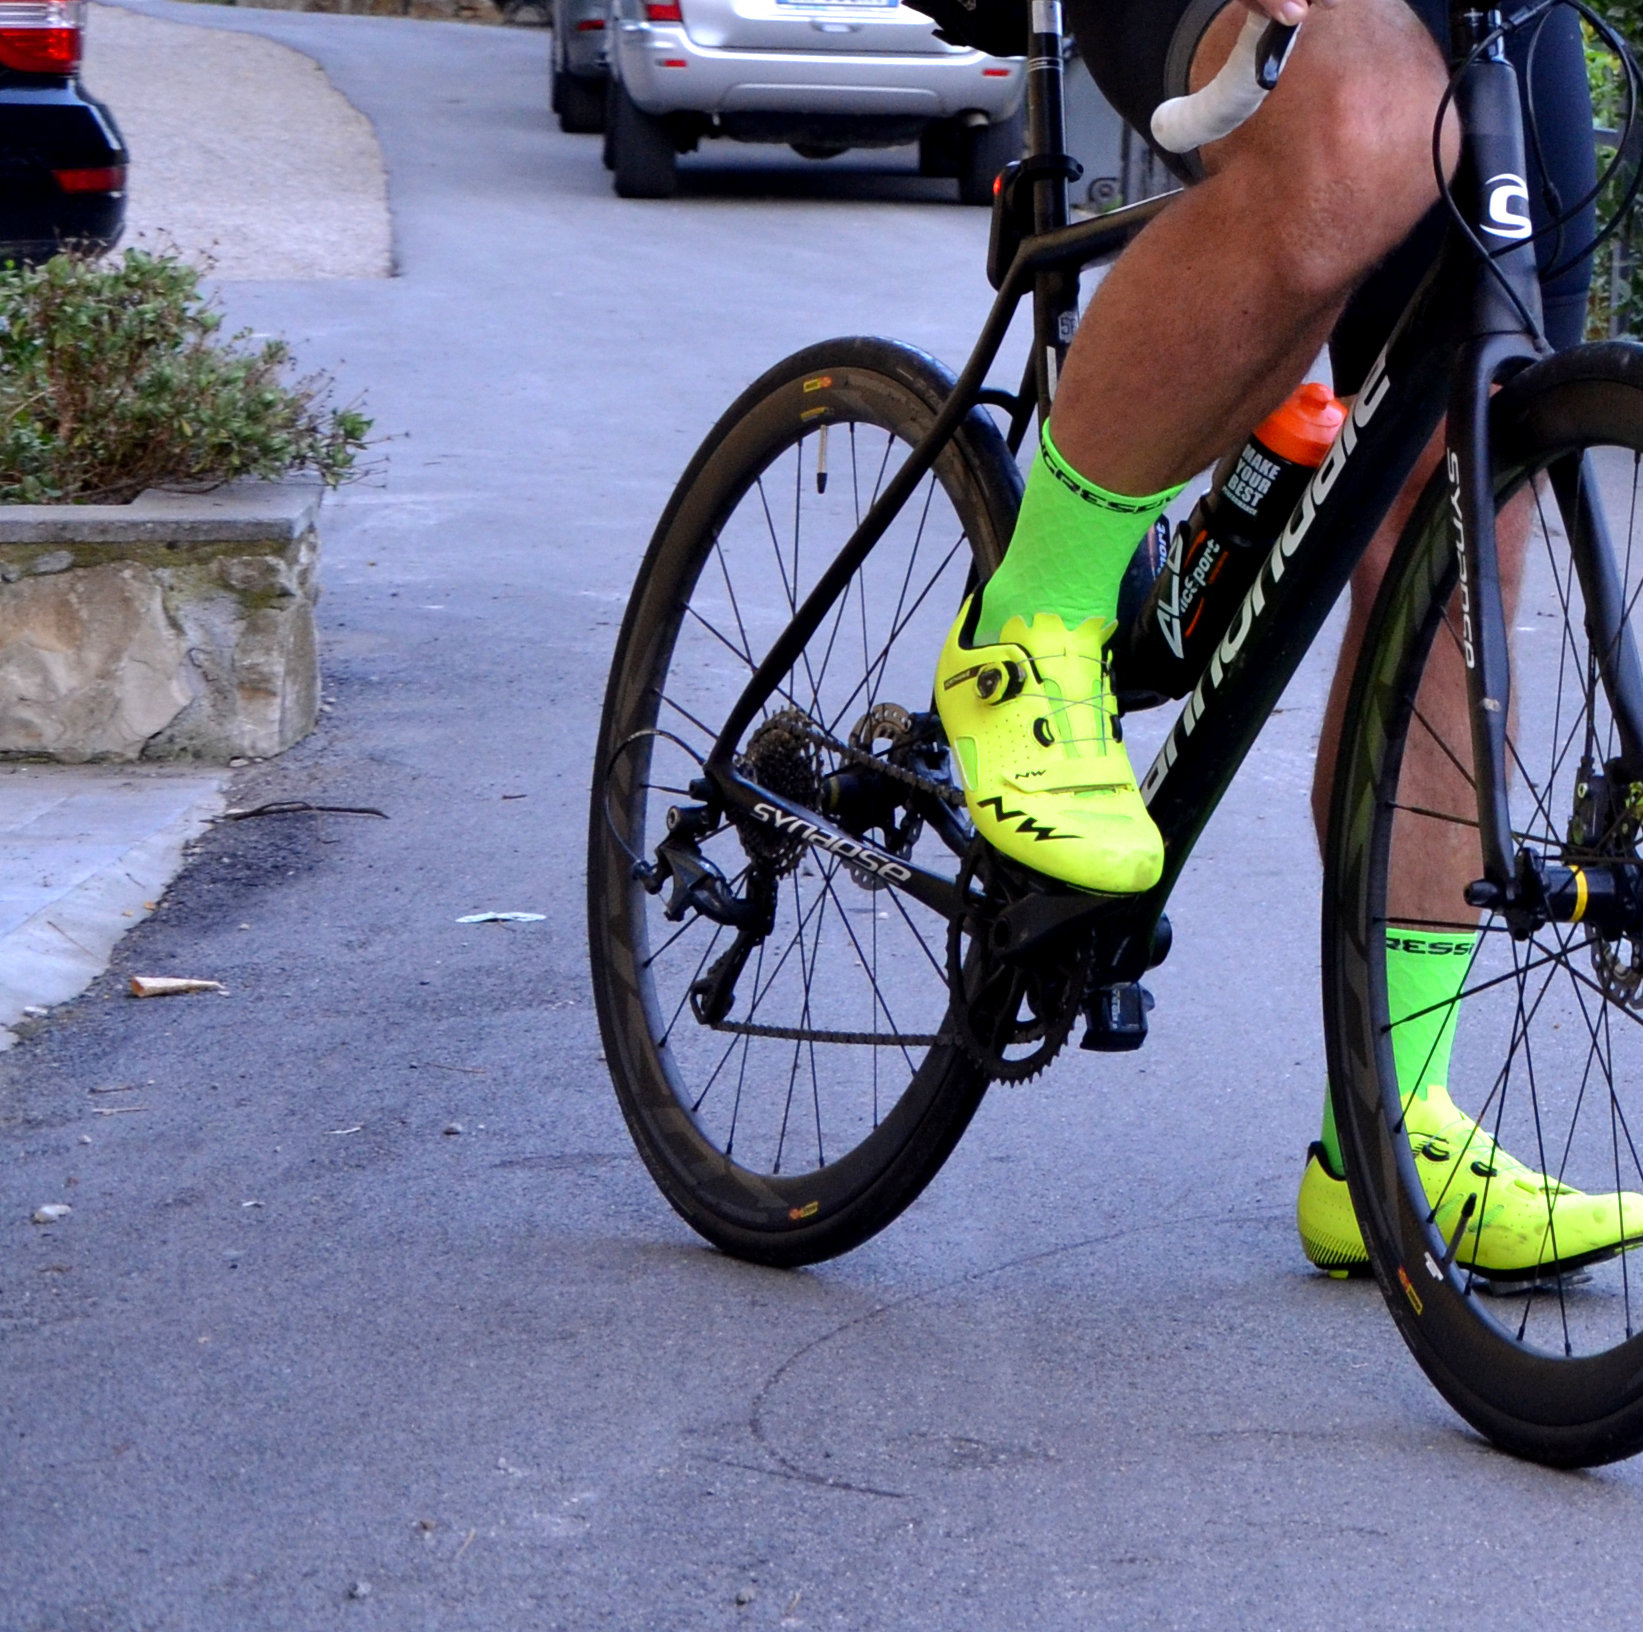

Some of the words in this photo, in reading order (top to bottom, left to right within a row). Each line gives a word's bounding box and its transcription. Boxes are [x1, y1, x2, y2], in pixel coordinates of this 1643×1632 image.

[1235, 458, 1272, 495] YOUR
[1242, 443, 1281, 481] MAKE
[1227, 473, 1264, 507] BEST
